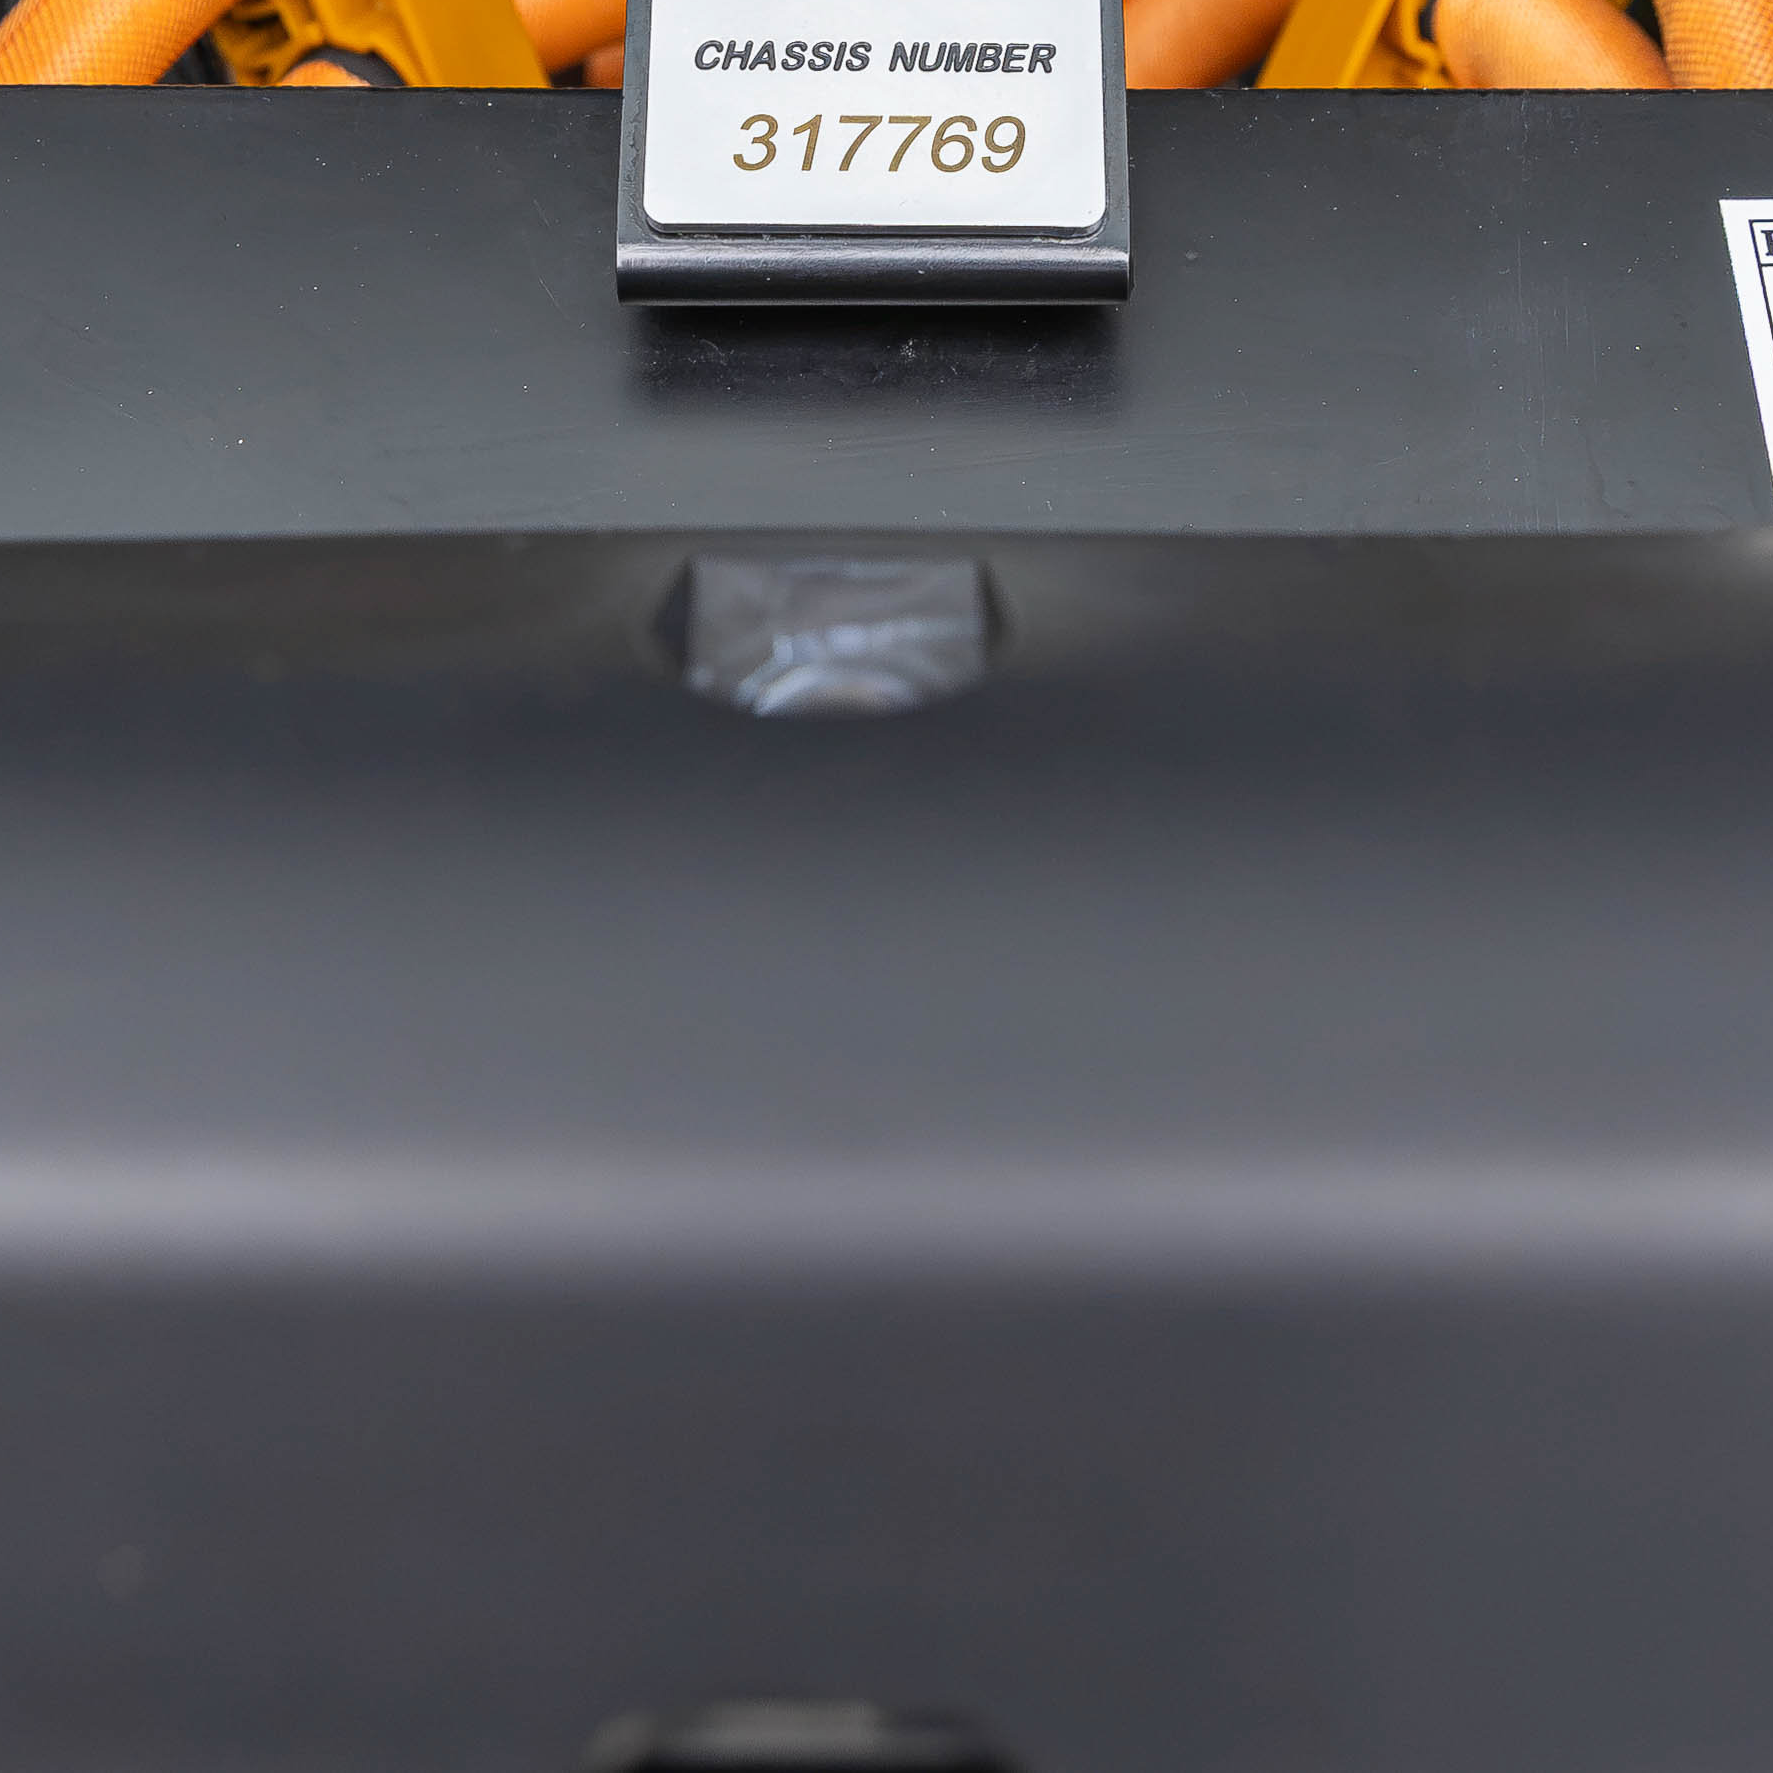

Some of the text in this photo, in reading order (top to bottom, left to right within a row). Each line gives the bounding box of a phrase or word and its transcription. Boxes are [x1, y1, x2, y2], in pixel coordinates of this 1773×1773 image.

[694, 39, 1057, 74] CHASSIS NUMBER
[733, 113, 1026, 174] 317769
